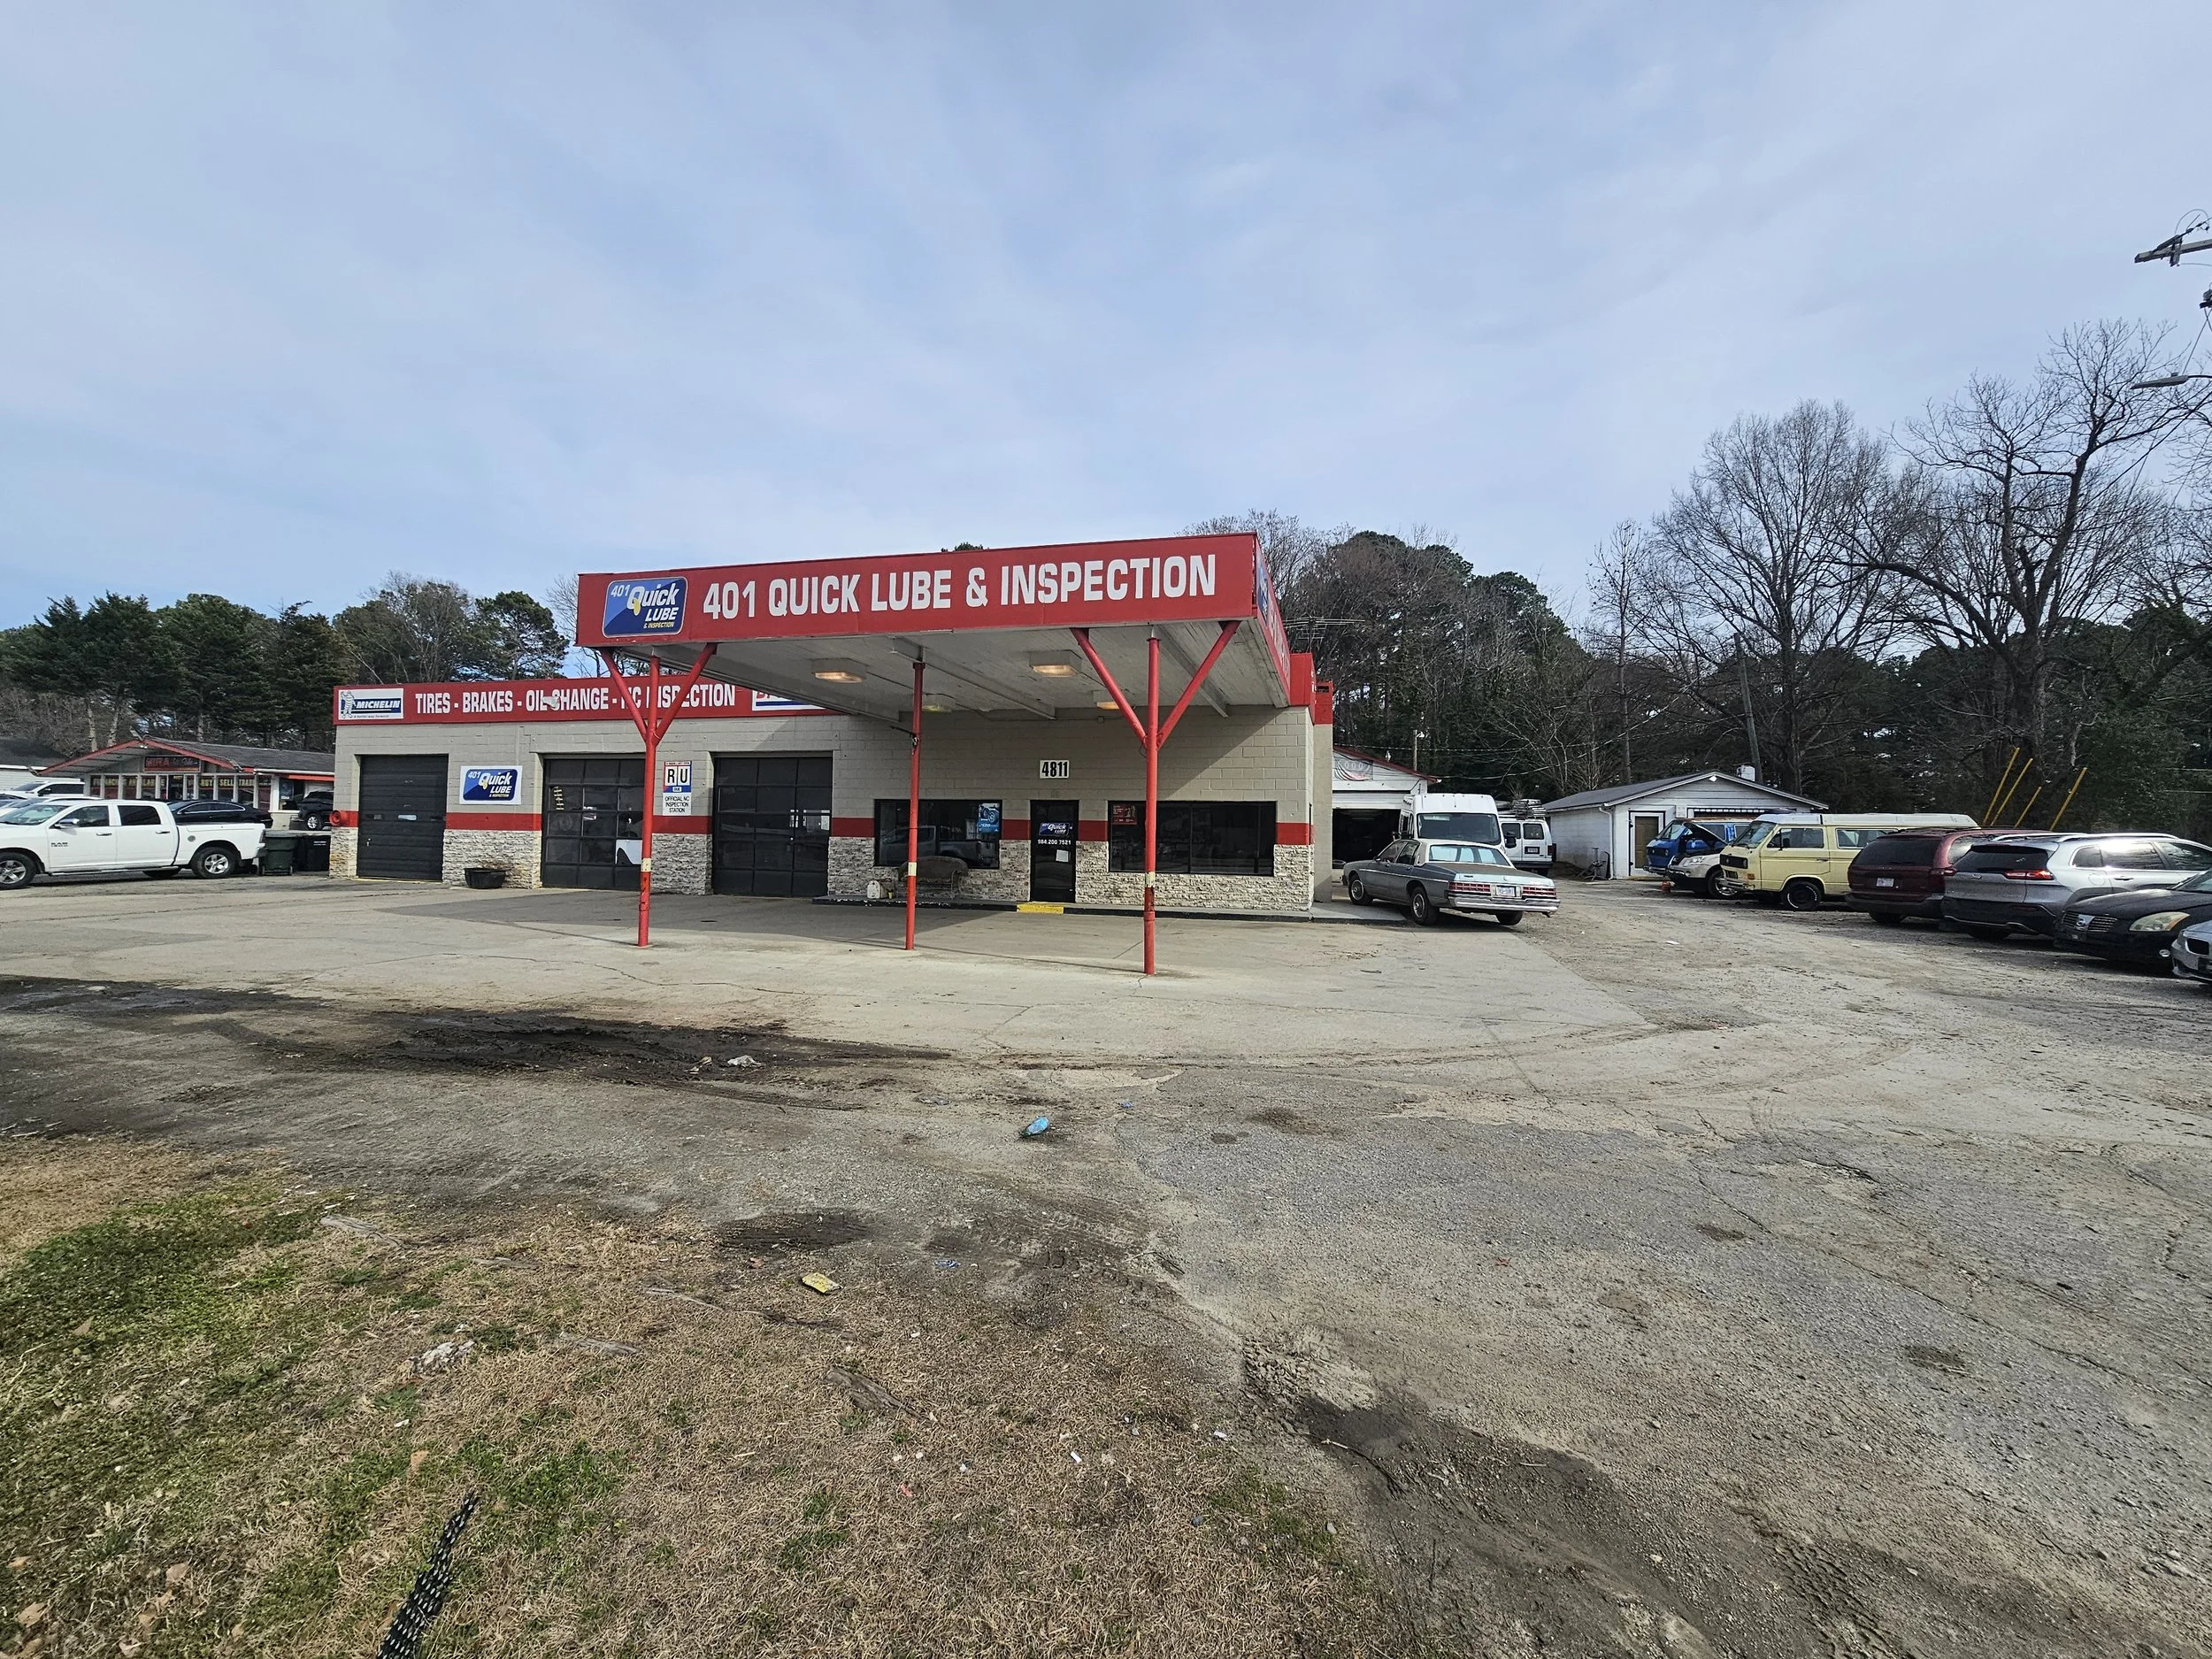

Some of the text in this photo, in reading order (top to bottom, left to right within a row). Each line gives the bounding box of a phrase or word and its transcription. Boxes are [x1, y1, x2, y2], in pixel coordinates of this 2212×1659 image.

[703, 580, 756, 619] 401
[768, 574, 861, 617] QUICK
[871, 570, 952, 611] LUBE
[966, 566, 987, 608] &
[1001, 554, 1216, 605] INSPECTION
[611, 582, 680, 616] 401 Quick
[644, 607, 680, 622] LUBE
[415, 692, 450, 714] TIRES
[462, 690, 513, 713] BRAKES
[526, 690, 547, 711] OIL
[550, 687, 609, 710] CHANGE
[667, 768, 687, 783] R U
[1041, 761, 1068, 777] 4811
[478, 772, 512, 789] Quick
